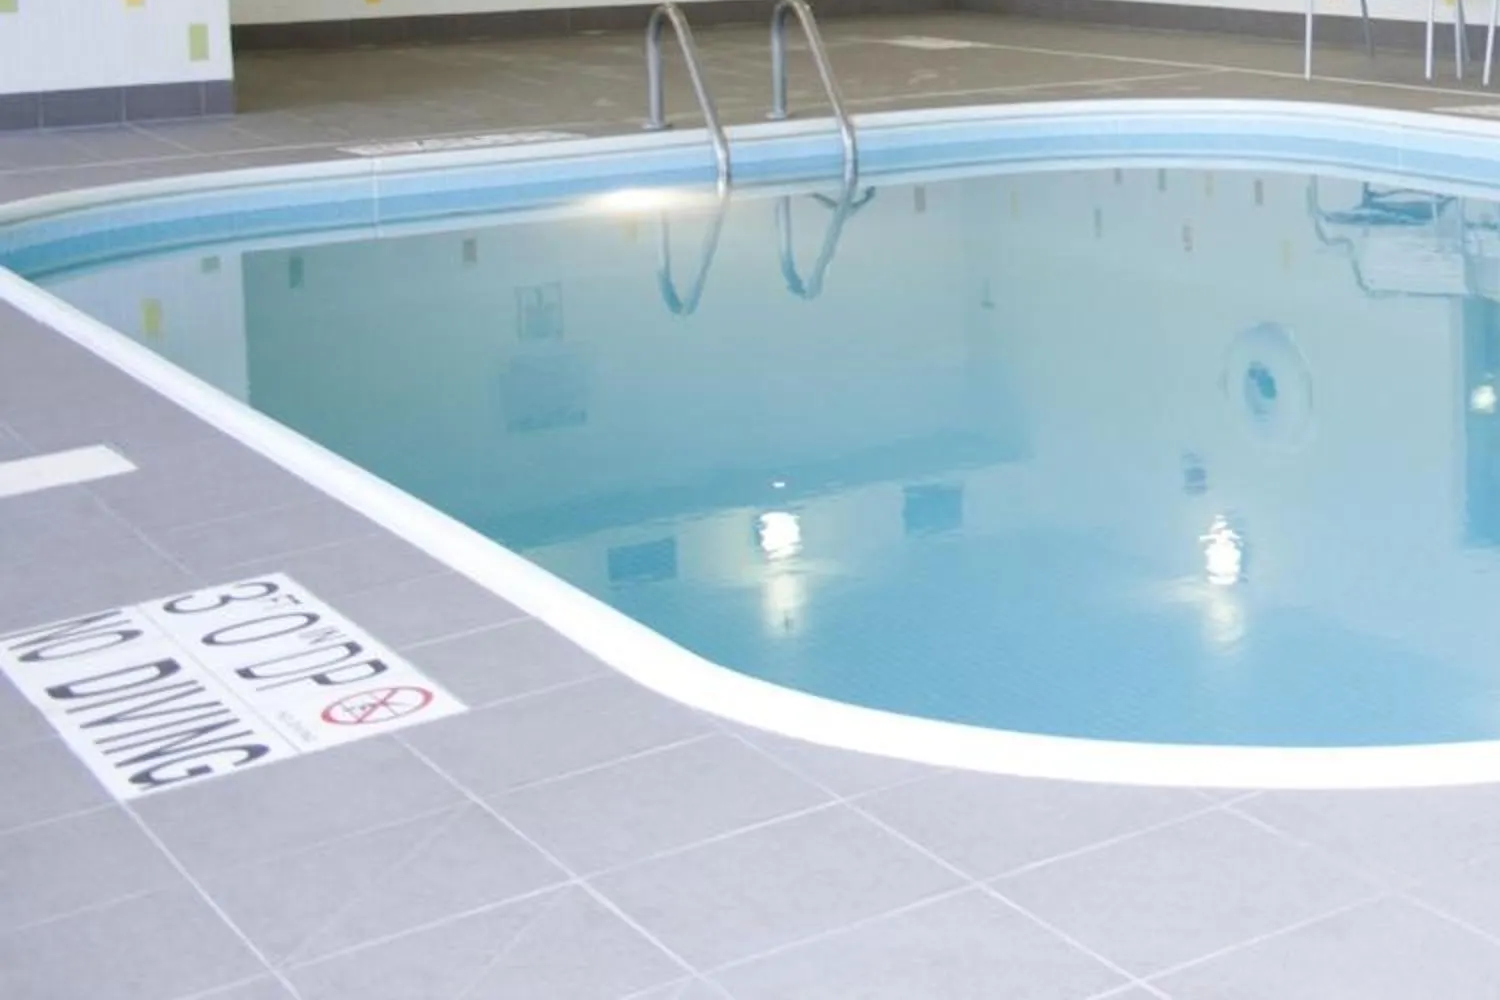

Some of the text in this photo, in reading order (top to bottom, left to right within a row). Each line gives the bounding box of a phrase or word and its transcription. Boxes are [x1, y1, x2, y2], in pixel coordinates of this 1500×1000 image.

[0, 610, 272, 791] NO DIVING
[234, 640, 389, 693] DP
